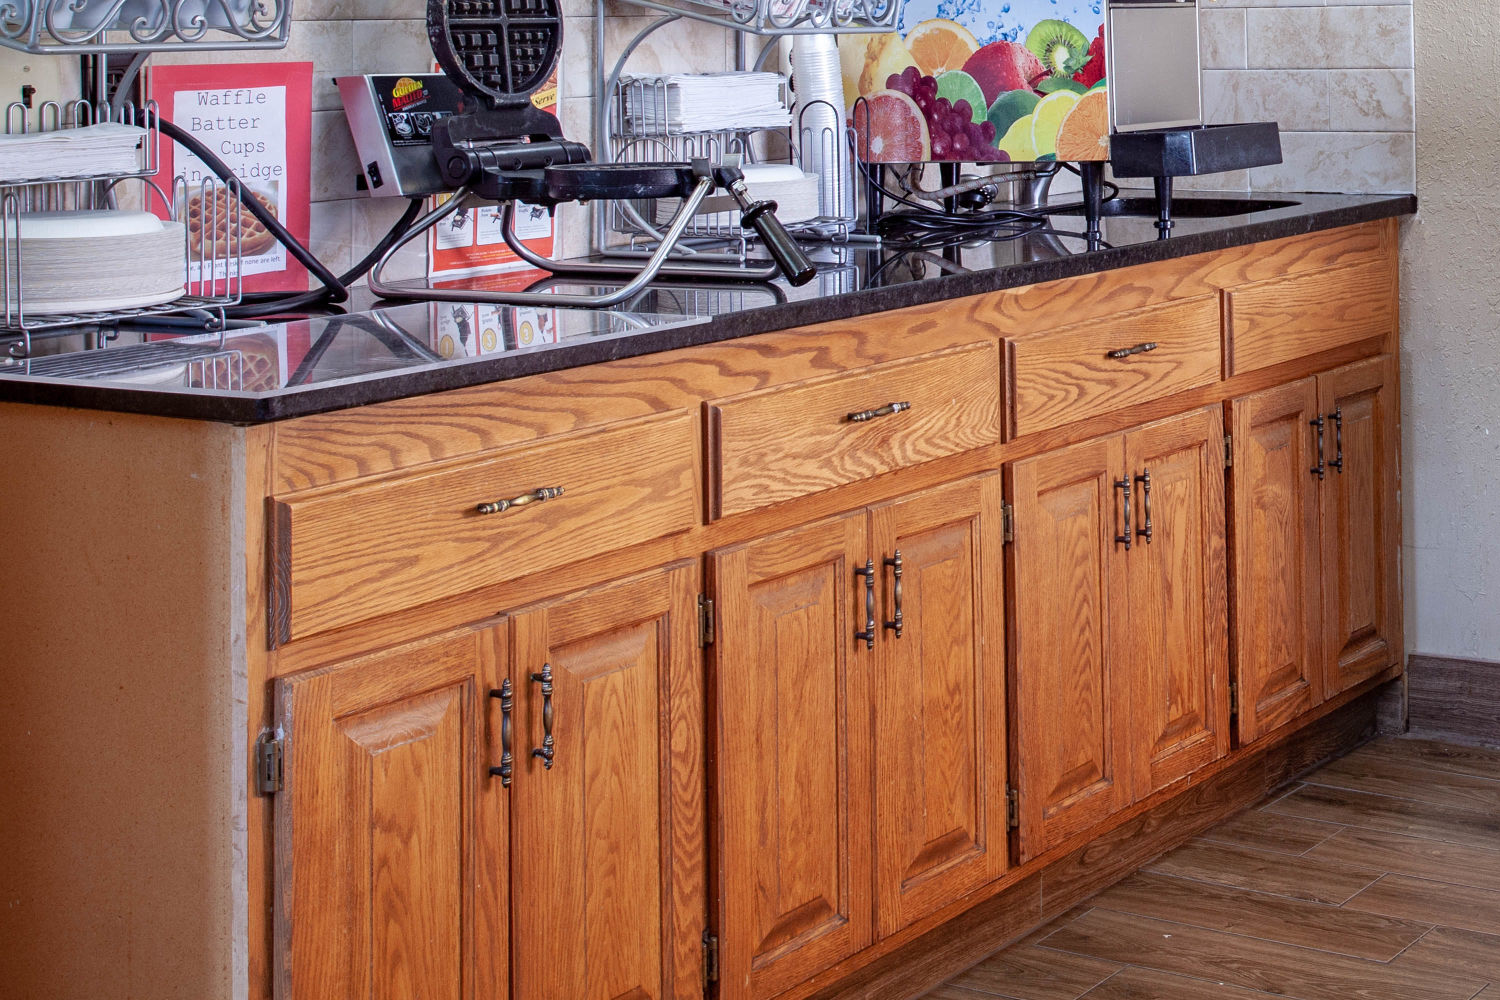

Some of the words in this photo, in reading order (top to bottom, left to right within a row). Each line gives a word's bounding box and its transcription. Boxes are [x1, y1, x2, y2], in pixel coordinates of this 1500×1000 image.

[197, 89, 267, 106] Waffle
[191, 116, 260, 132] Batter
[220, 140, 266, 158] Cups
[180, 166, 201, 182] in
[270, 255, 281, 263] left
